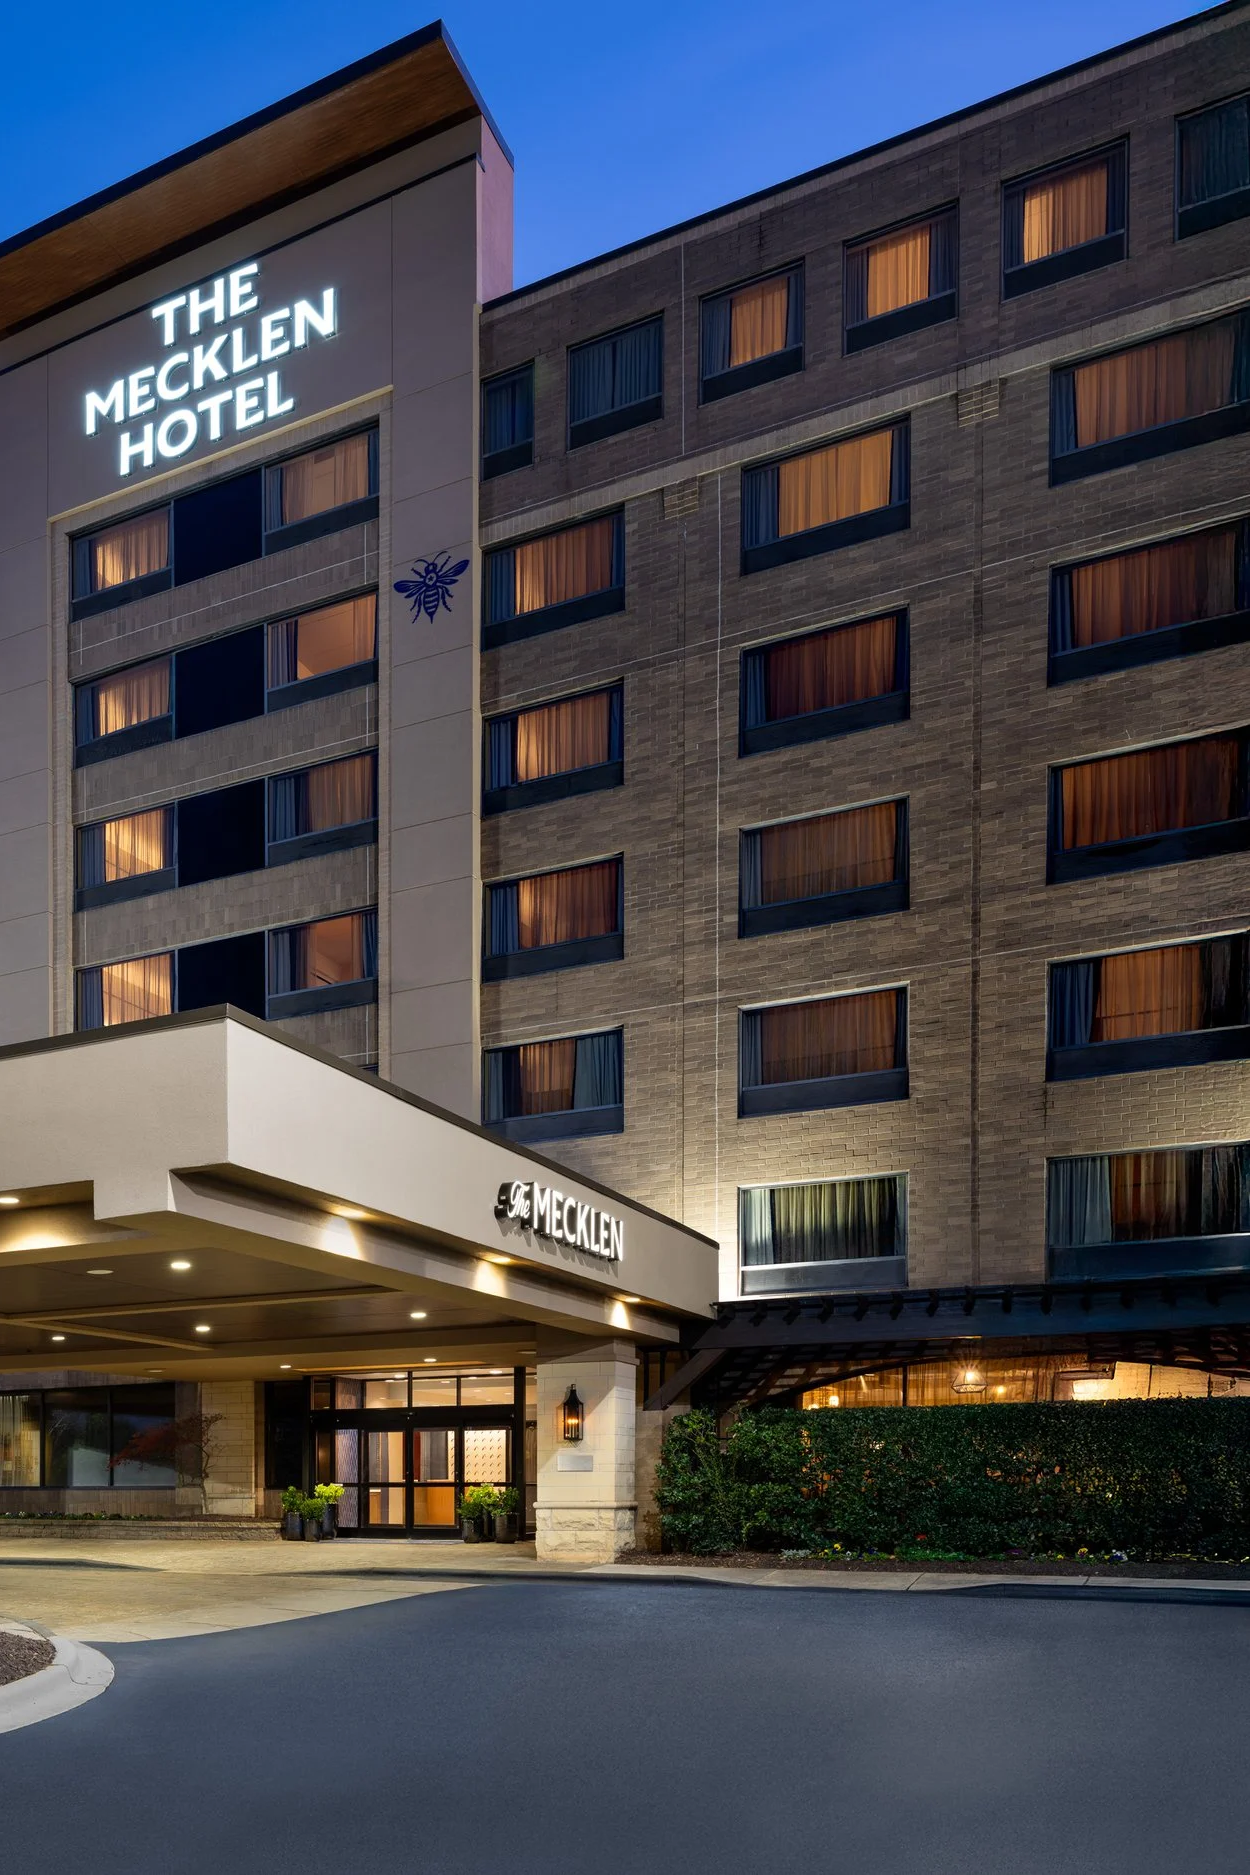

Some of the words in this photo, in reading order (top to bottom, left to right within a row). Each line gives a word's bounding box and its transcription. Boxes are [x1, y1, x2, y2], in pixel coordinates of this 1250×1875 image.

[151, 263, 259, 347] THE
[85, 287, 336, 436] MECKLEN
[119, 371, 294, 477] HOTEL
[503, 1180, 531, 1219] The
[532, 1181, 624, 1262] MECKLEN
